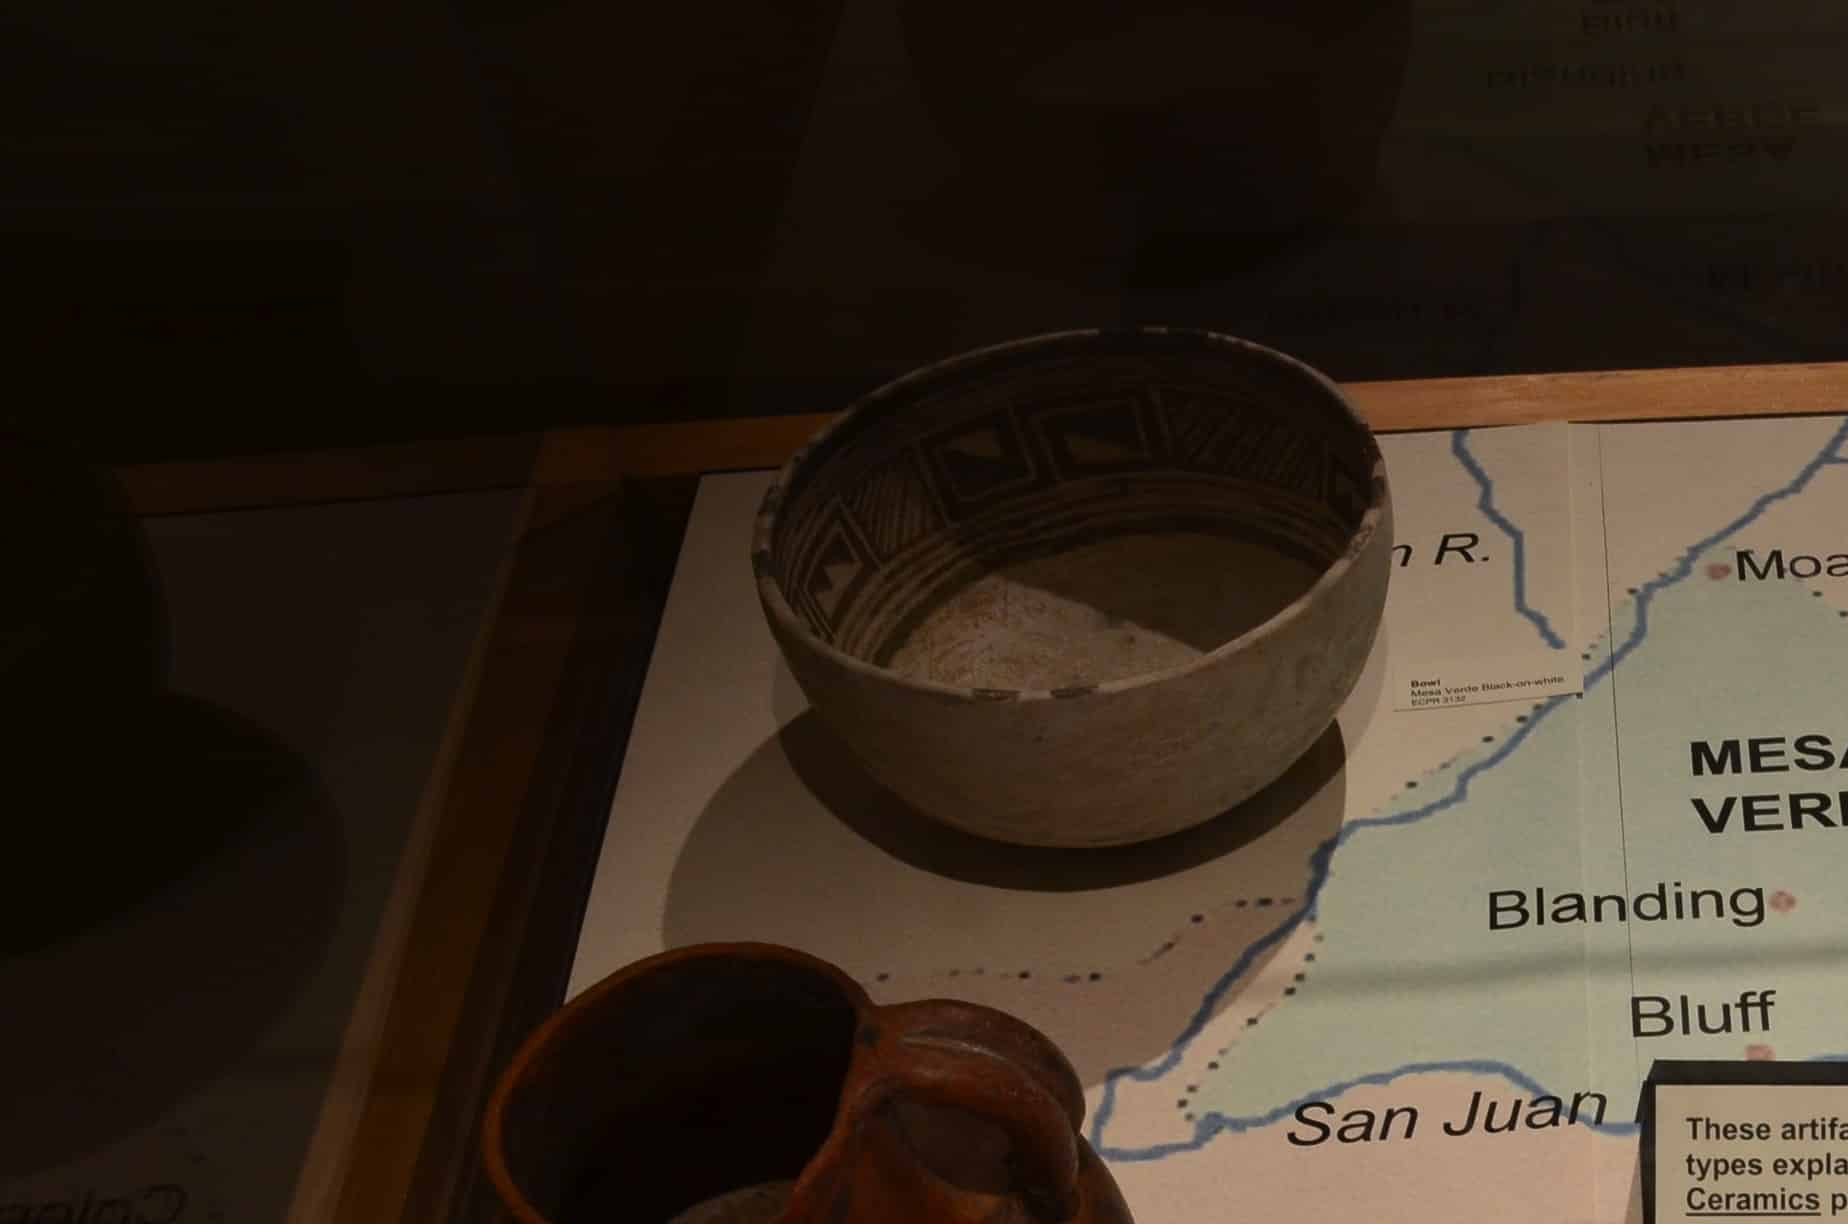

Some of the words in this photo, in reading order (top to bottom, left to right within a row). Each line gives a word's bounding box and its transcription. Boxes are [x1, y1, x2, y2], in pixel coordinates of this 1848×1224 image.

[1434, 532, 1490, 566] R.
[1410, 679, 1441, 688] Bowl
[1488, 880, 1766, 930] Blanding
[1630, 990, 1776, 1038] Bluff
[1287, 1100, 1419, 1148] San
[1443, 1085, 1608, 1140] Juan
[1686, 1117, 1771, 1141] These
[1686, 1153, 1763, 1180] types
[1686, 1188, 1821, 1212] Ceramics
